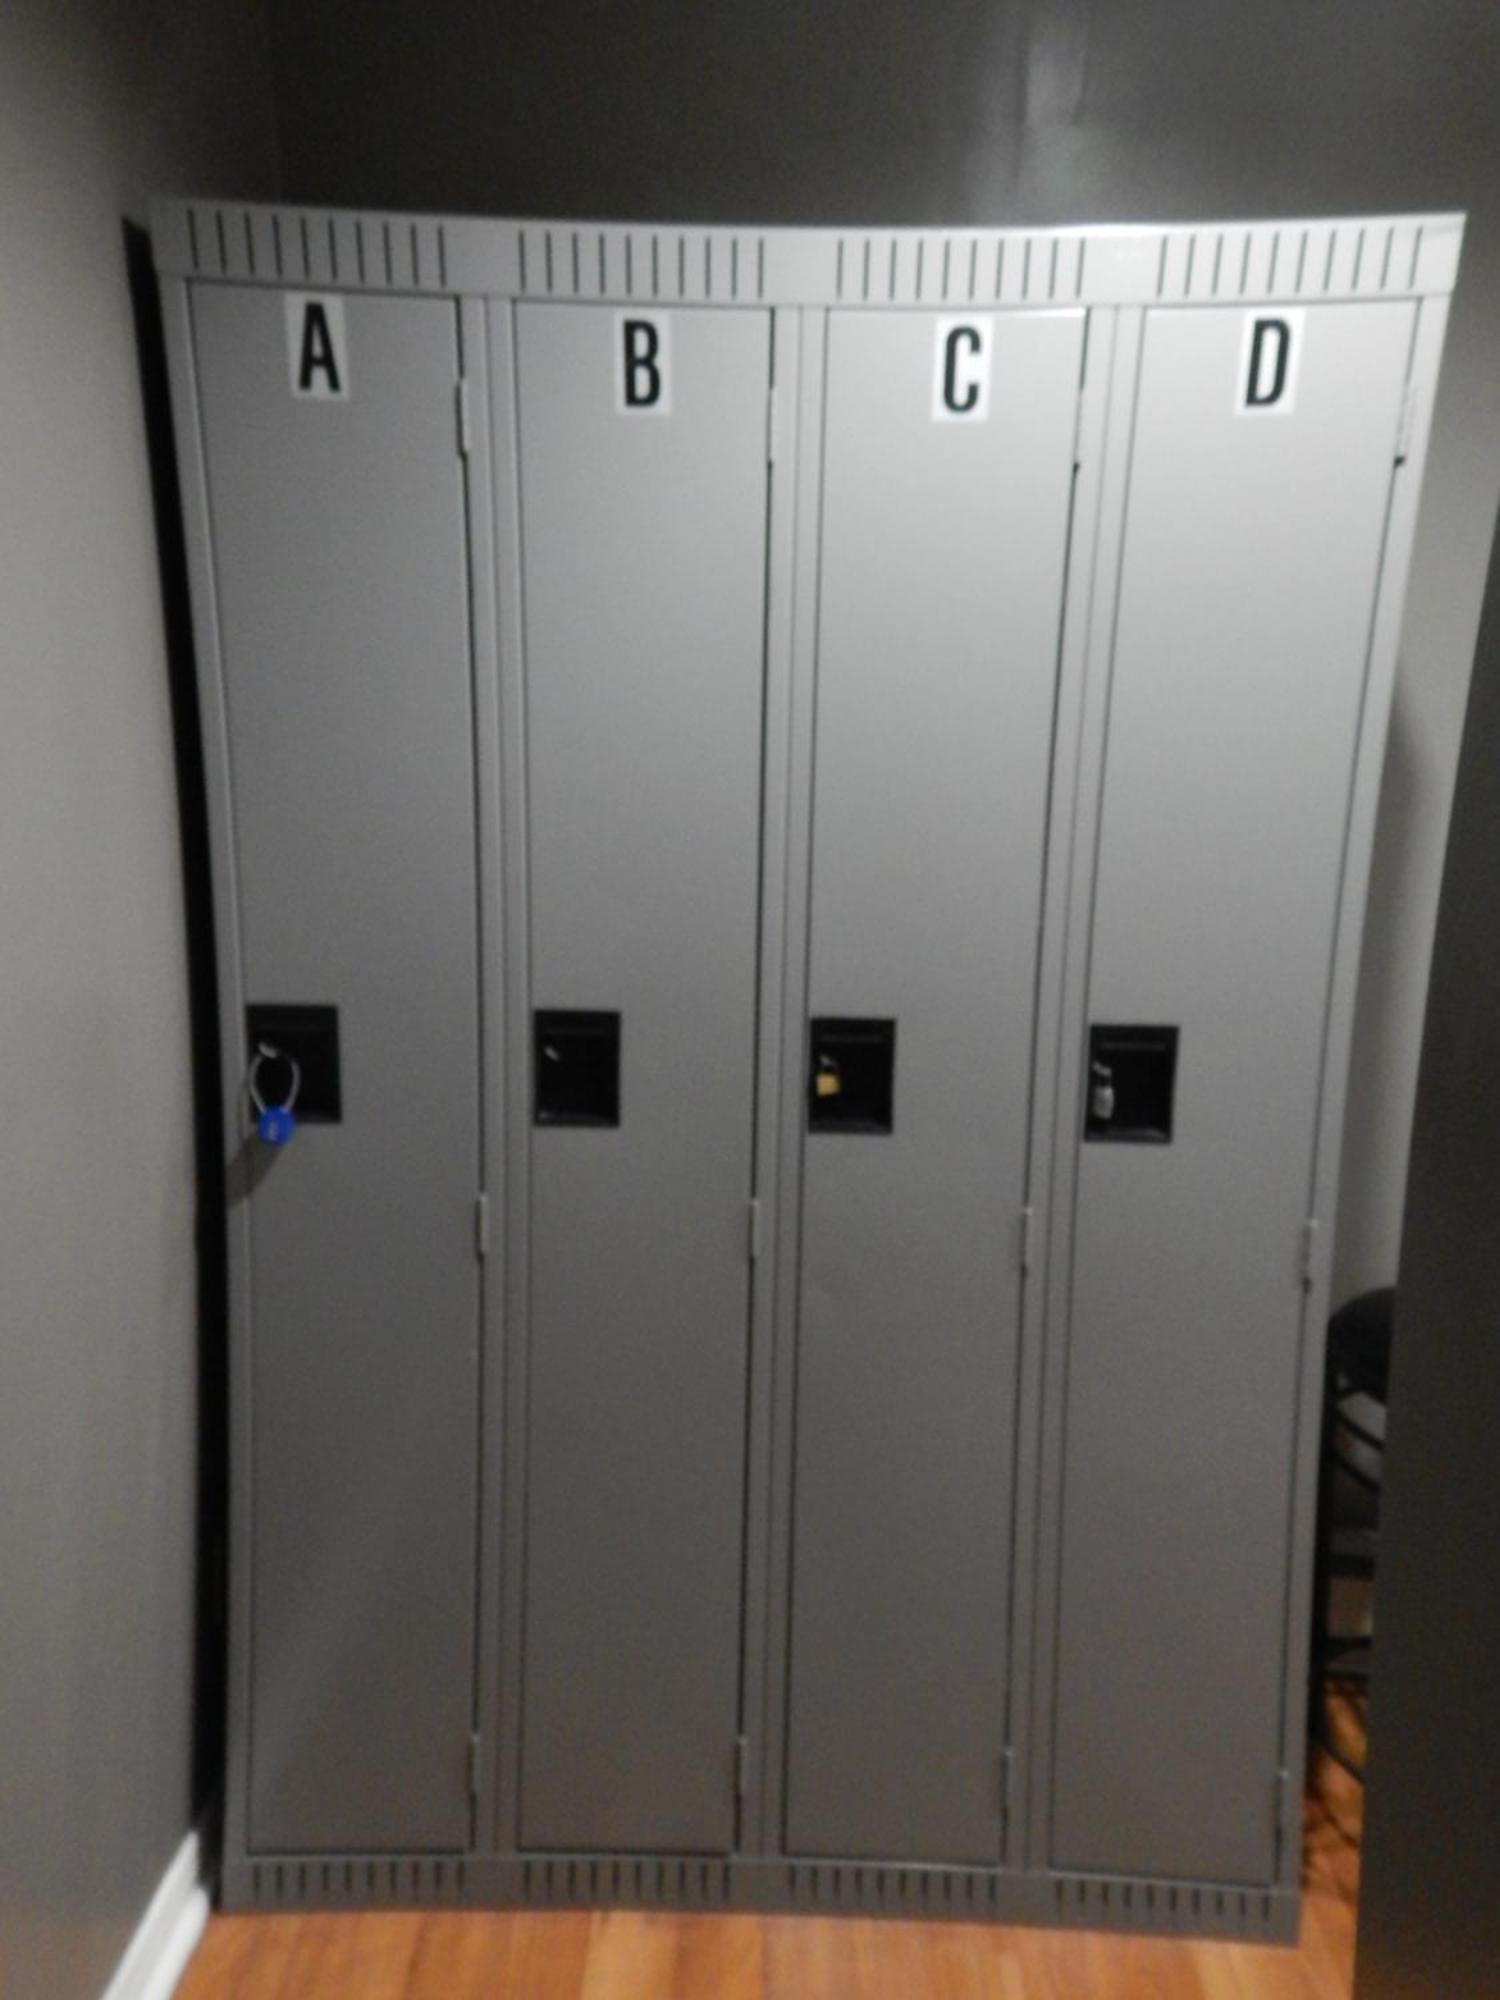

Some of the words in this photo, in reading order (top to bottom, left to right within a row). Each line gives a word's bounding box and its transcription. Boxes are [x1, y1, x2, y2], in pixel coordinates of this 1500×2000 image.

[299, 302, 341, 393] A
[624, 319, 661, 408] B
[942, 325, 982, 413] C
[1244, 319, 1291, 408] D
